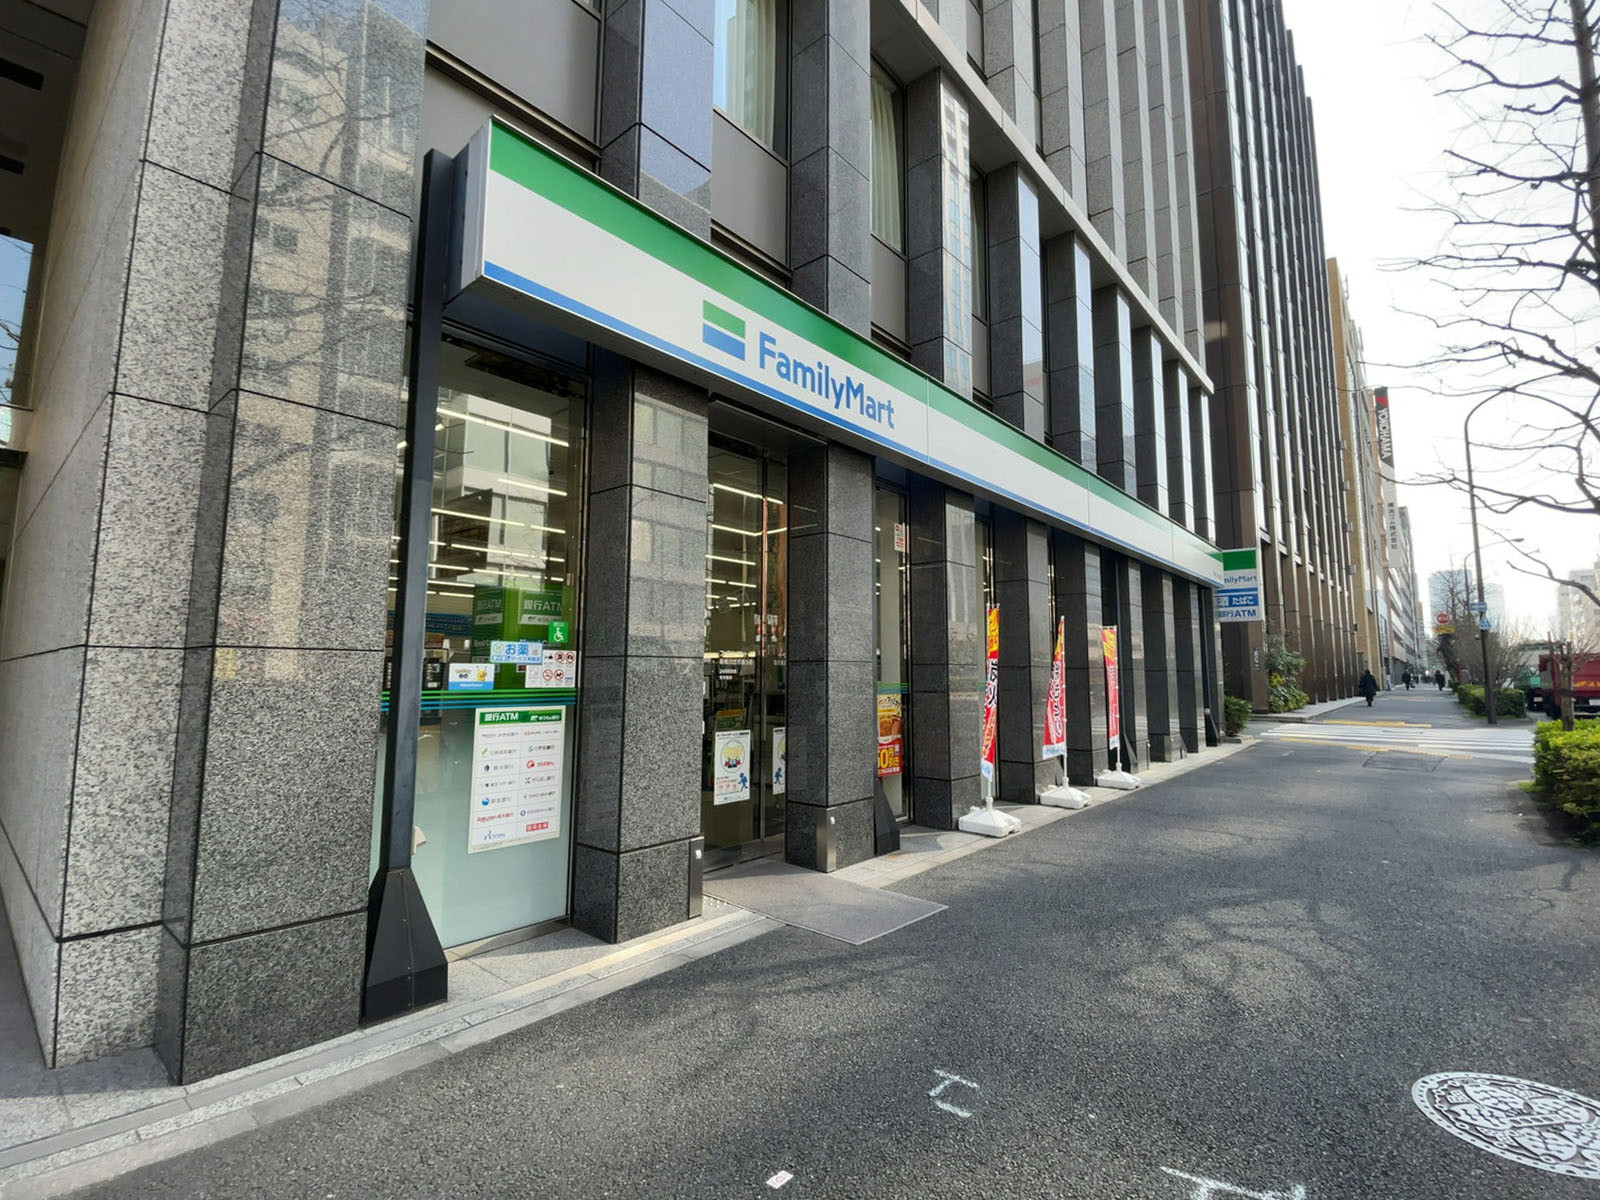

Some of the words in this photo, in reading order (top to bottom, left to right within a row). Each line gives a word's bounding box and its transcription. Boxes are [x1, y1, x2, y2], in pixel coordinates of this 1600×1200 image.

[759, 330, 895, 430] FamilyMart
[1378, 407, 1392, 459] YOKOHAMA
[484, 712, 519, 722] 銀行ATM
